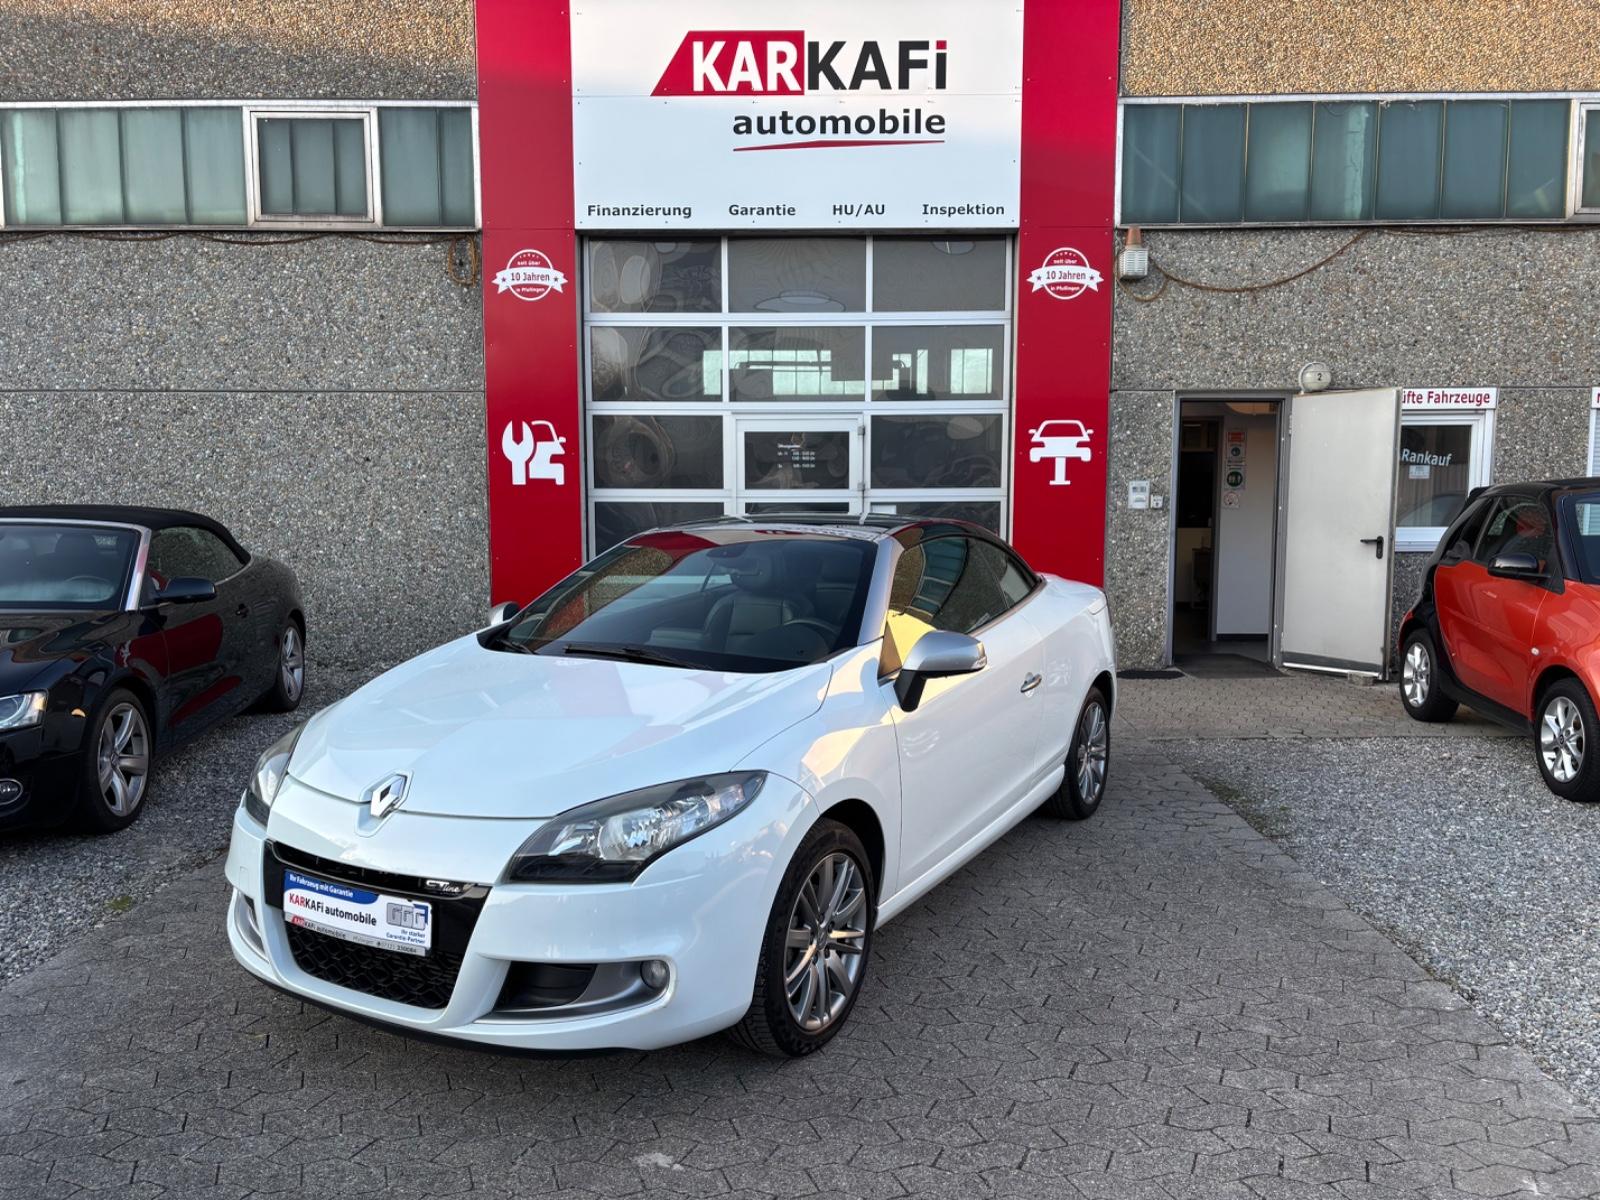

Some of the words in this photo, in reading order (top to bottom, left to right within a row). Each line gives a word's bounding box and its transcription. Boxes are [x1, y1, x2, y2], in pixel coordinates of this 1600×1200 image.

[692, 40, 947, 91] KARKAFi
[733, 109, 946, 134] automobile
[587, 204, 692, 218] Finanzierung
[728, 204, 796, 216] Garantie
[832, 204, 885, 217] HU/AU
[922, 203, 1005, 217] Inspektion
[511, 272, 521, 281] 10
[522, 272, 550, 281] Jahren
[1046, 270, 1056, 280] 10
[1058, 270, 1086, 280] Jahren
[1427, 390, 1490, 406] Fahrzeuge
[297, 875, 319, 891] Fahrzeug
[320, 883, 329, 892] mit
[329, 885, 354, 898] Garantie
[289, 892, 324, 913] KARKAFi
[325, 905, 377, 926] automobile
